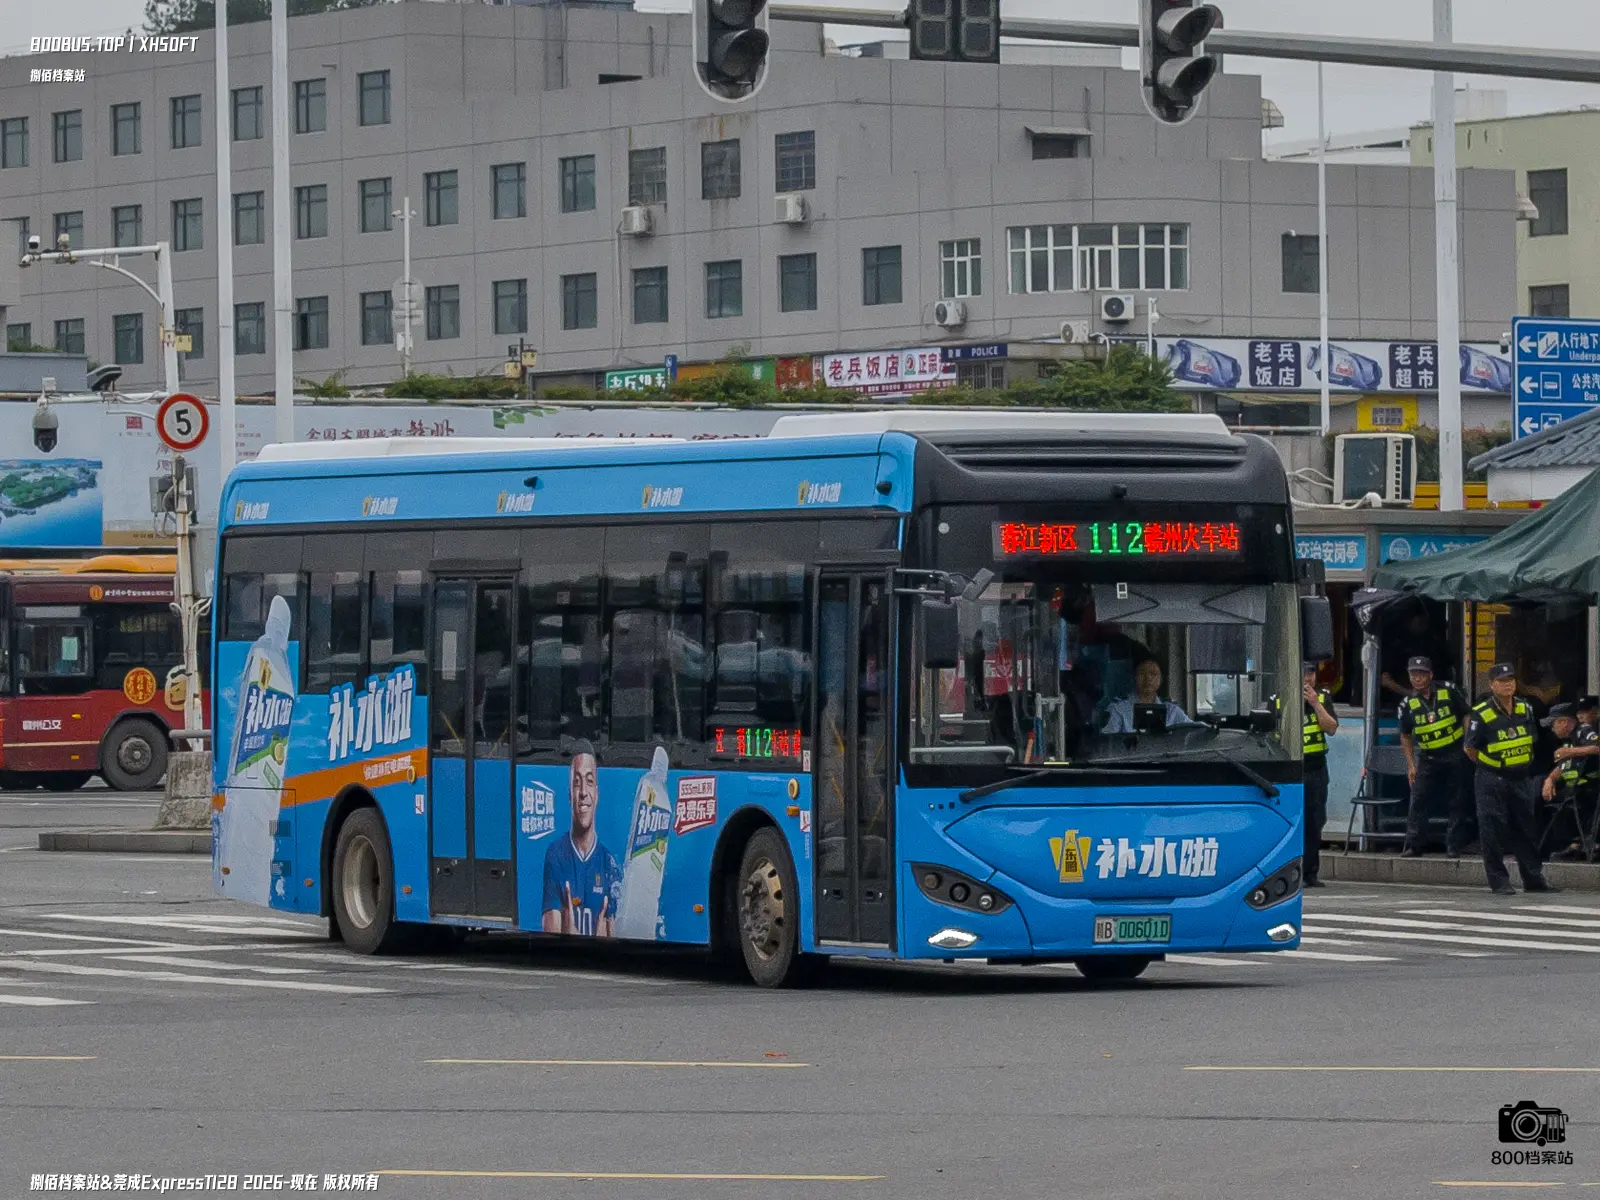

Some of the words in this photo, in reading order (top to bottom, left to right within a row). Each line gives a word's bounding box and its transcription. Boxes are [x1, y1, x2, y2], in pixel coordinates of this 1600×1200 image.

[971, 346, 998, 357] POLICE
[1255, 343, 1295, 363] 老兵
[1395, 345, 1434, 365] 老兵
[829, 354, 900, 381] 老兵饭店
[1255, 366, 1295, 386] 饭店
[1395, 368, 1434, 388] 超市
[1584, 391, 1598, 401] Bus
[176, 409, 192, 435] 5
[1089, 522, 1144, 554] 112
[246, 688, 294, 735] 补水啦
[328, 669, 415, 761] 补水啦
[1096, 837, 1219, 879] 补水啦
